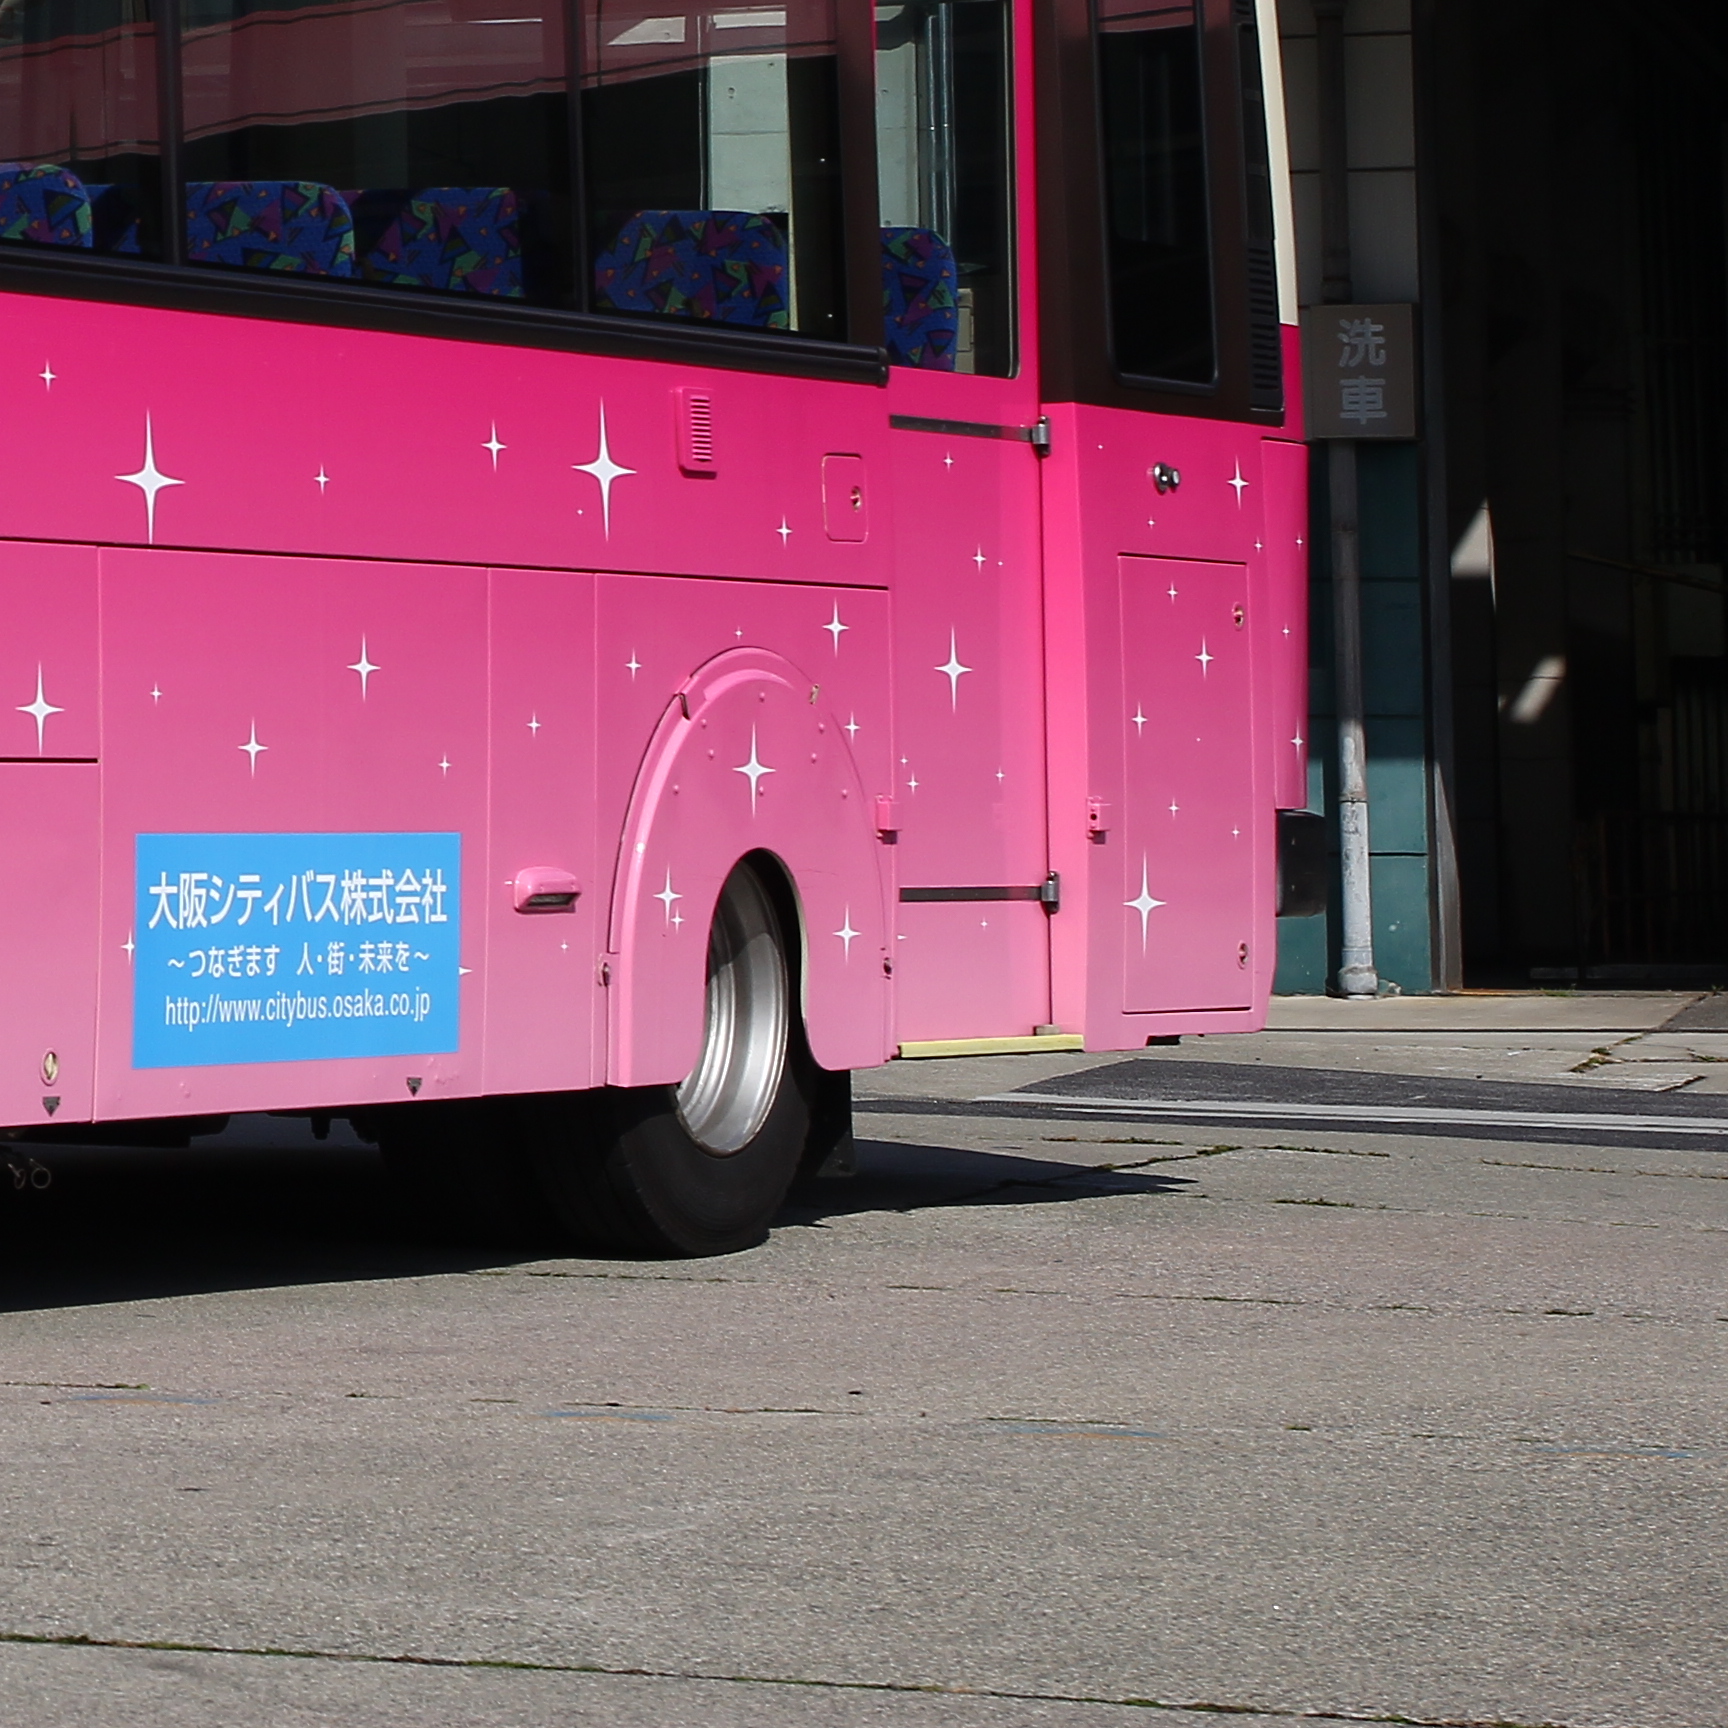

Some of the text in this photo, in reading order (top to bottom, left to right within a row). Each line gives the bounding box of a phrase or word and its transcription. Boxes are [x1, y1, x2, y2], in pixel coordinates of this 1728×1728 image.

[1337, 317, 1388, 425] 洗車
[148, 868, 448, 930] 大阪シティバス株式会社
[165, 986, 431, 1032] http://www.citybus.osaka.co.jp
